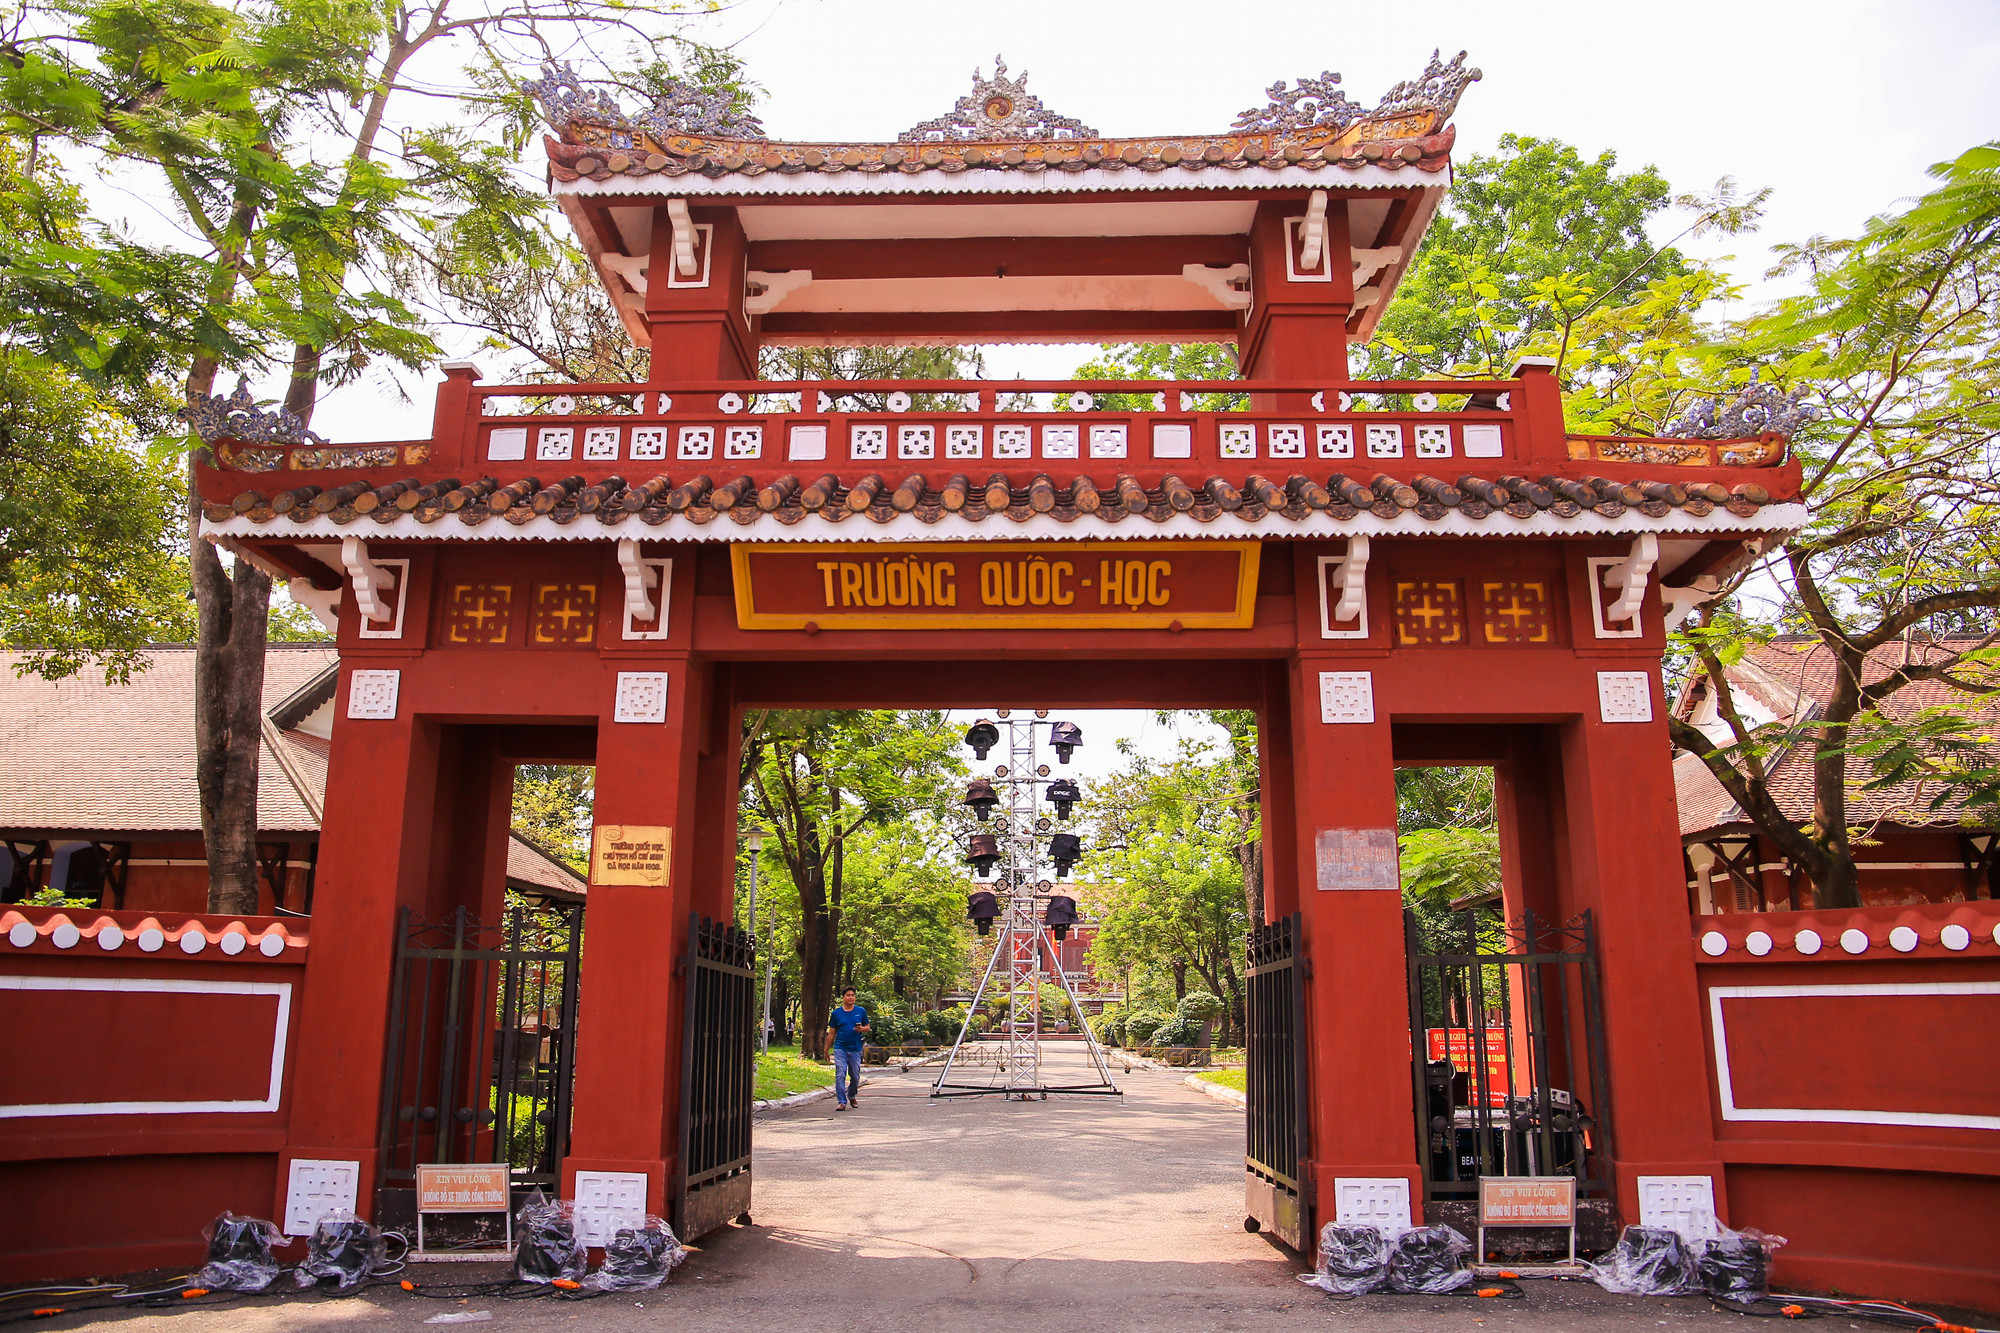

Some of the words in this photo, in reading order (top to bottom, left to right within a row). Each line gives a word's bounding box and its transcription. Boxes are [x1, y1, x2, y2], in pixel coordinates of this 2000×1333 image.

[816, 554, 956, 607] TRƯỜNG
[980, 554, 1074, 606] QUỐC
[1100, 559, 1172, 612] HỌC
[436, 1175, 450, 1184] XIN
[452, 1175, 467, 1184] VUI
[468, 1172, 491, 1184] LÒNG
[1500, 1188, 1514, 1197] XIN
[1516, 1188, 1533, 1197] VUI
[1533, 1185, 1556, 1197] LÒNG
